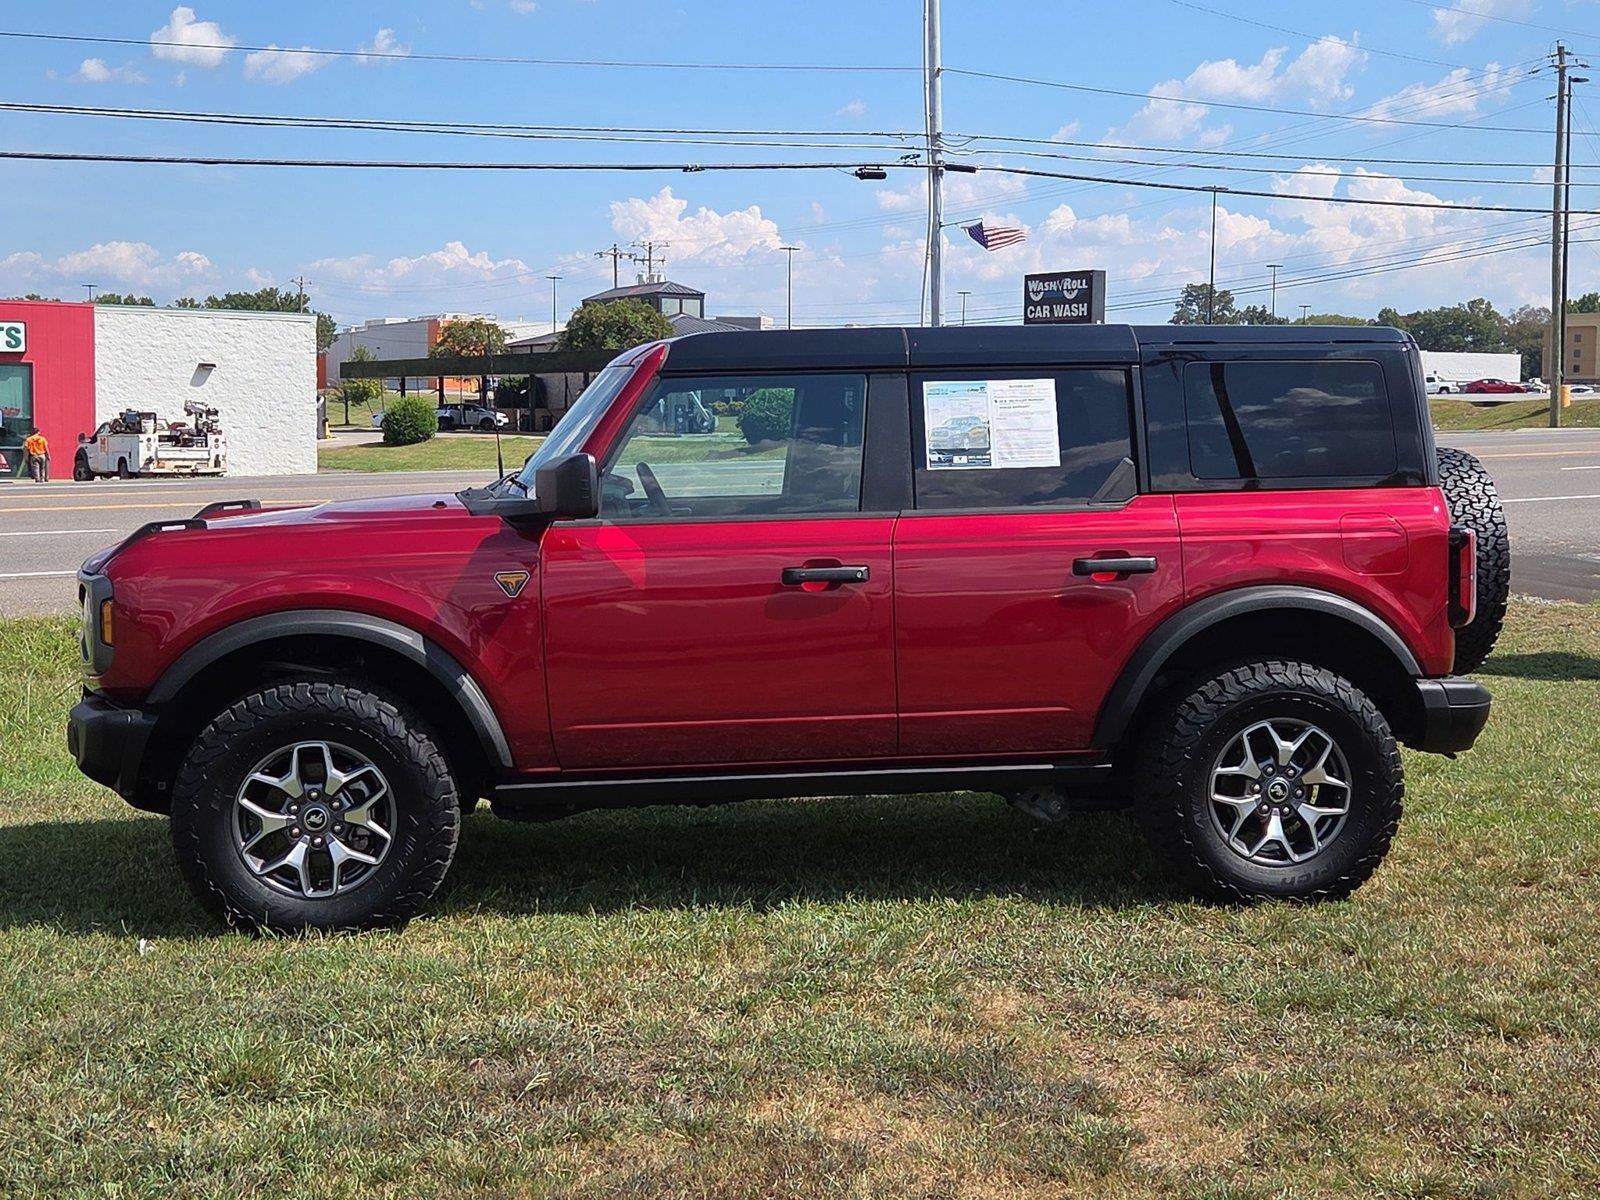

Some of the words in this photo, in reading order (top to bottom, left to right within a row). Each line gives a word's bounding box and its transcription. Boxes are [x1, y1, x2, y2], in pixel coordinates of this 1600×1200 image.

[1027, 305, 1050, 318] CAR
[1053, 303, 1088, 317] WASH
[0, 326, 22, 349] S
